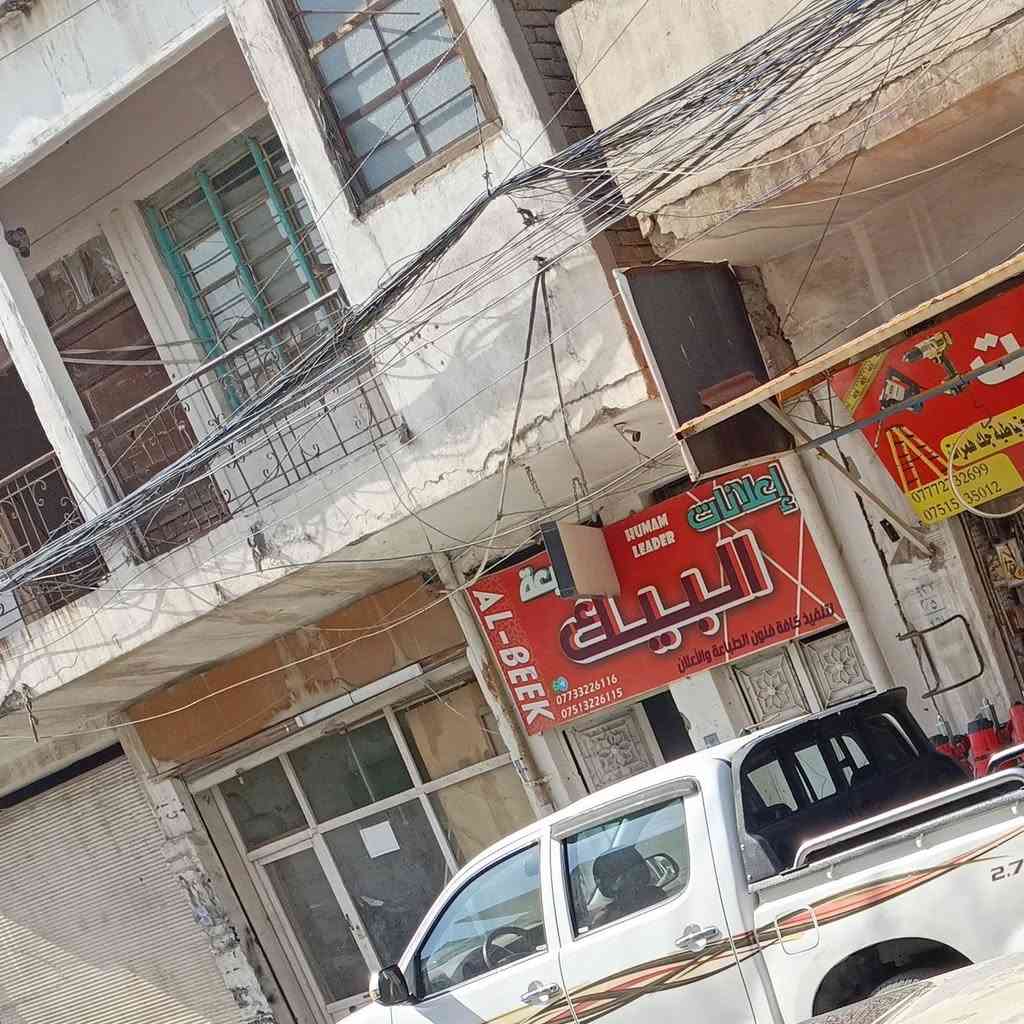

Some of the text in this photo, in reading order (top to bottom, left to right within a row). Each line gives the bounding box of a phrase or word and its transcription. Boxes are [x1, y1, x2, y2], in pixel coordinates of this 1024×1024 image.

[687, 462, 798, 531] إعلانات
[910, 462, 989, 504] 0777232699
[921, 480, 1002, 521] 0751535012
[630, 529, 676, 558] LEADER
[560, 528, 773, 664] البيك
[471, 589, 555, 726] AL-BEEK
[554, 673, 618, 705] 07733226116
[559, 687, 624, 718] 07513226115
[991, 860, 1024, 882] 2.7
